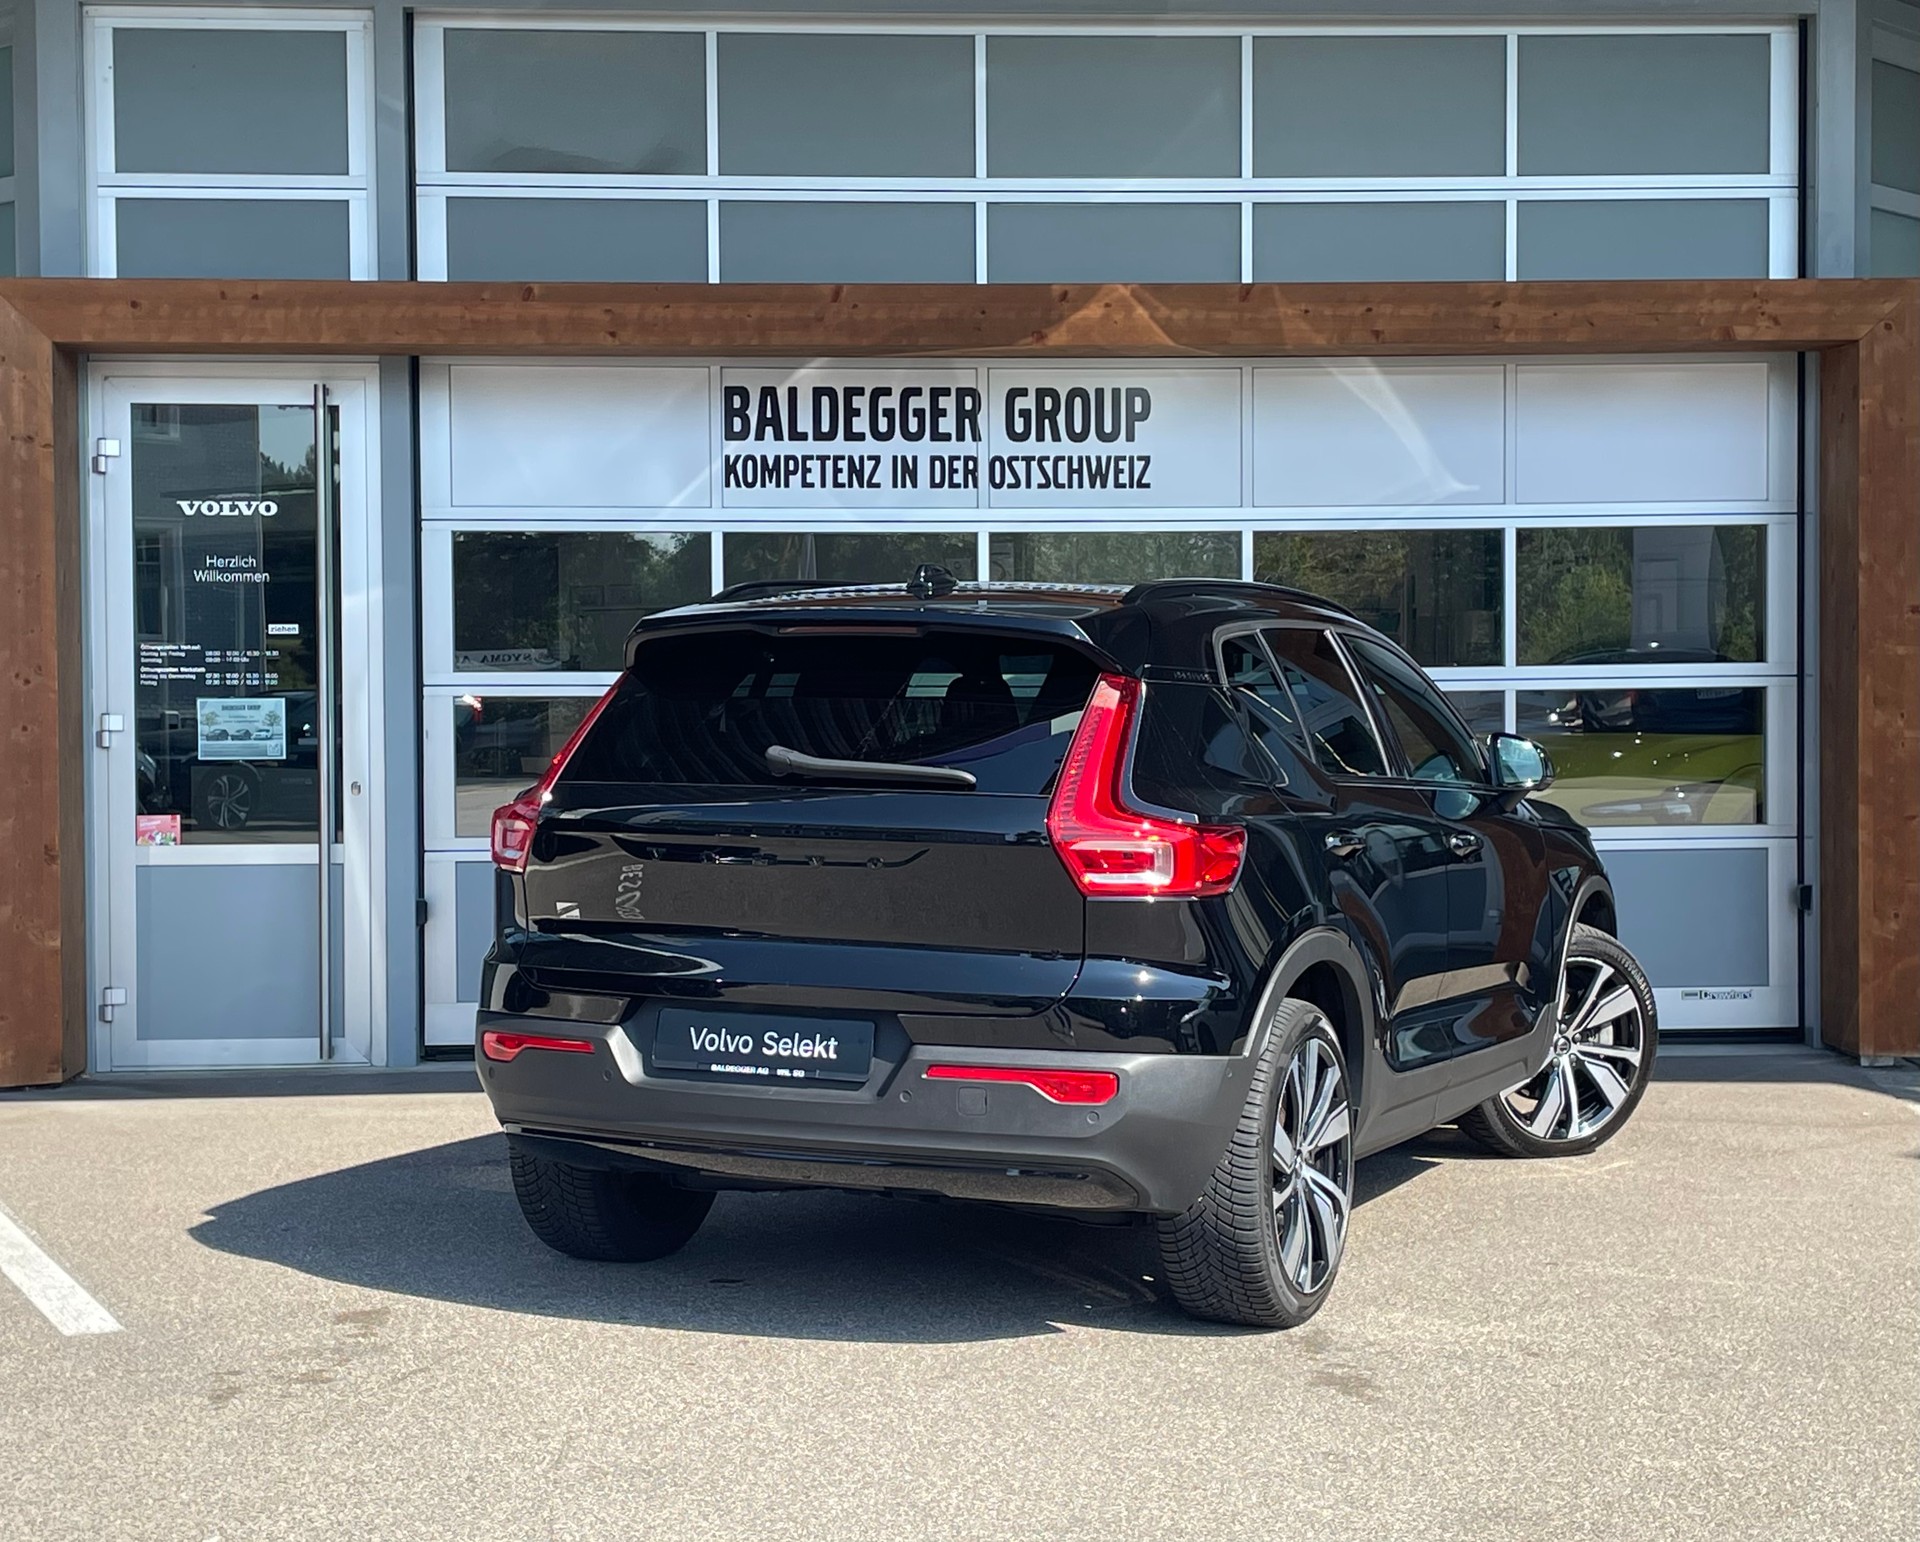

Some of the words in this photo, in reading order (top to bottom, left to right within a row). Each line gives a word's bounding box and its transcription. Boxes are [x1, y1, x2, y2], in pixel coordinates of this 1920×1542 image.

[724, 386, 982, 442] BALDEGGER
[1005, 387, 1152, 443] GROUP
[724, 454, 881, 488] KOMPETENZ
[892, 455, 918, 488] IN
[929, 455, 978, 489] DER
[989, 455, 1151, 489] OSTSCHWEIZ
[176, 500, 278, 517] VOLVO
[206, 554, 257, 568] Herzlich
[193, 569, 270, 582] Willkommen
[270, 625, 297, 633] ziehen
[690, 1026, 753, 1054] Volvo
[762, 1031, 839, 1060] Selekt
